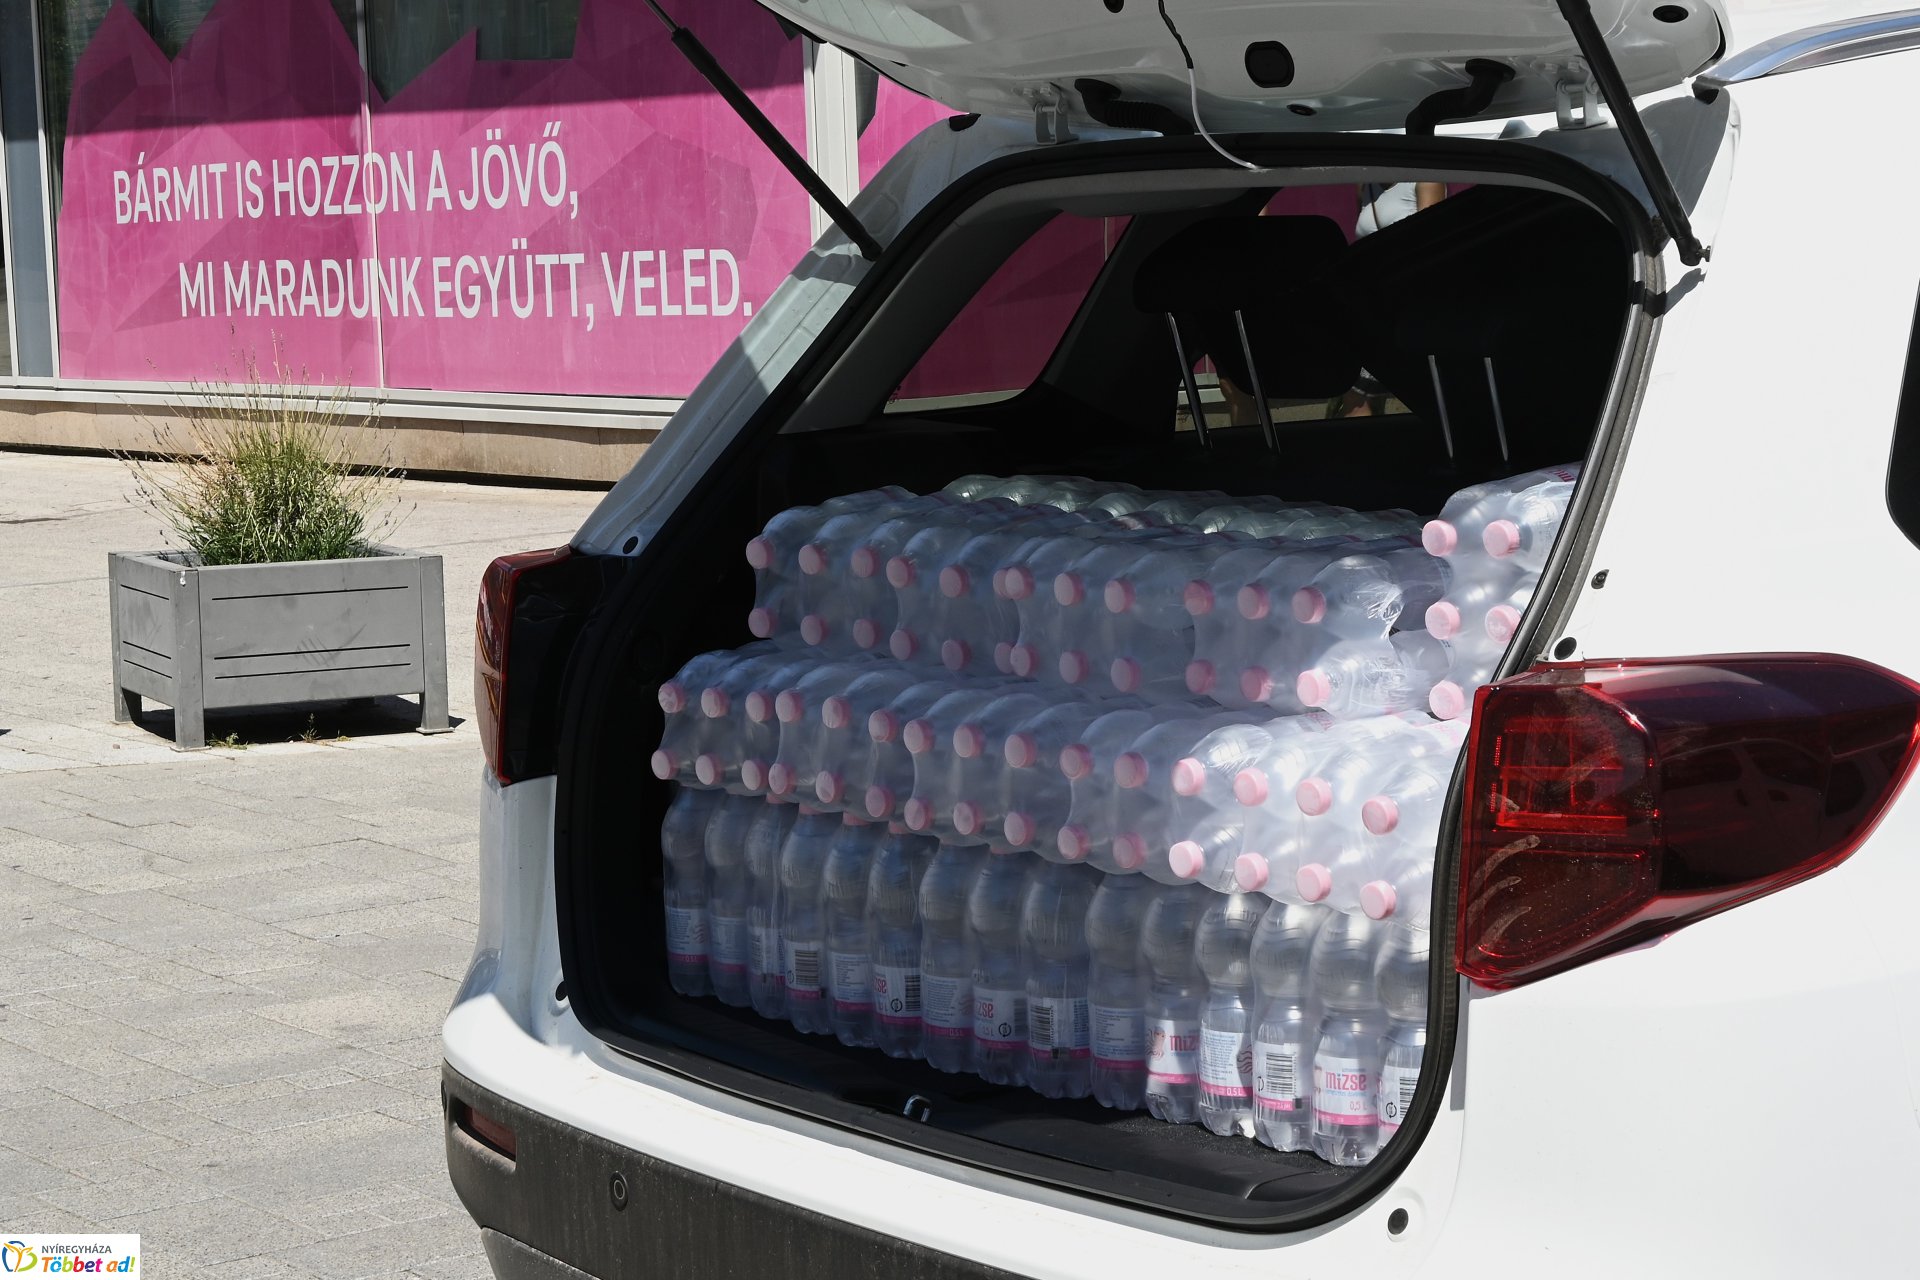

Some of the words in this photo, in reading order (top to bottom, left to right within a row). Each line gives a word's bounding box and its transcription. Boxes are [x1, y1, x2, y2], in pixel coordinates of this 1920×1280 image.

[114, 151, 228, 225] BÁRMIT
[235, 160, 264, 219] IS
[273, 150, 417, 217] HOZZON
[425, 149, 453, 212] A
[458, 120, 579, 220] JÖVŐ,
[179, 261, 216, 318] MI
[223, 256, 425, 318] MARADUNK
[432, 238, 595, 333] EGYÜTT,
[600, 248, 753, 318] VELED.
[1170, 1034, 1201, 1052] miz
